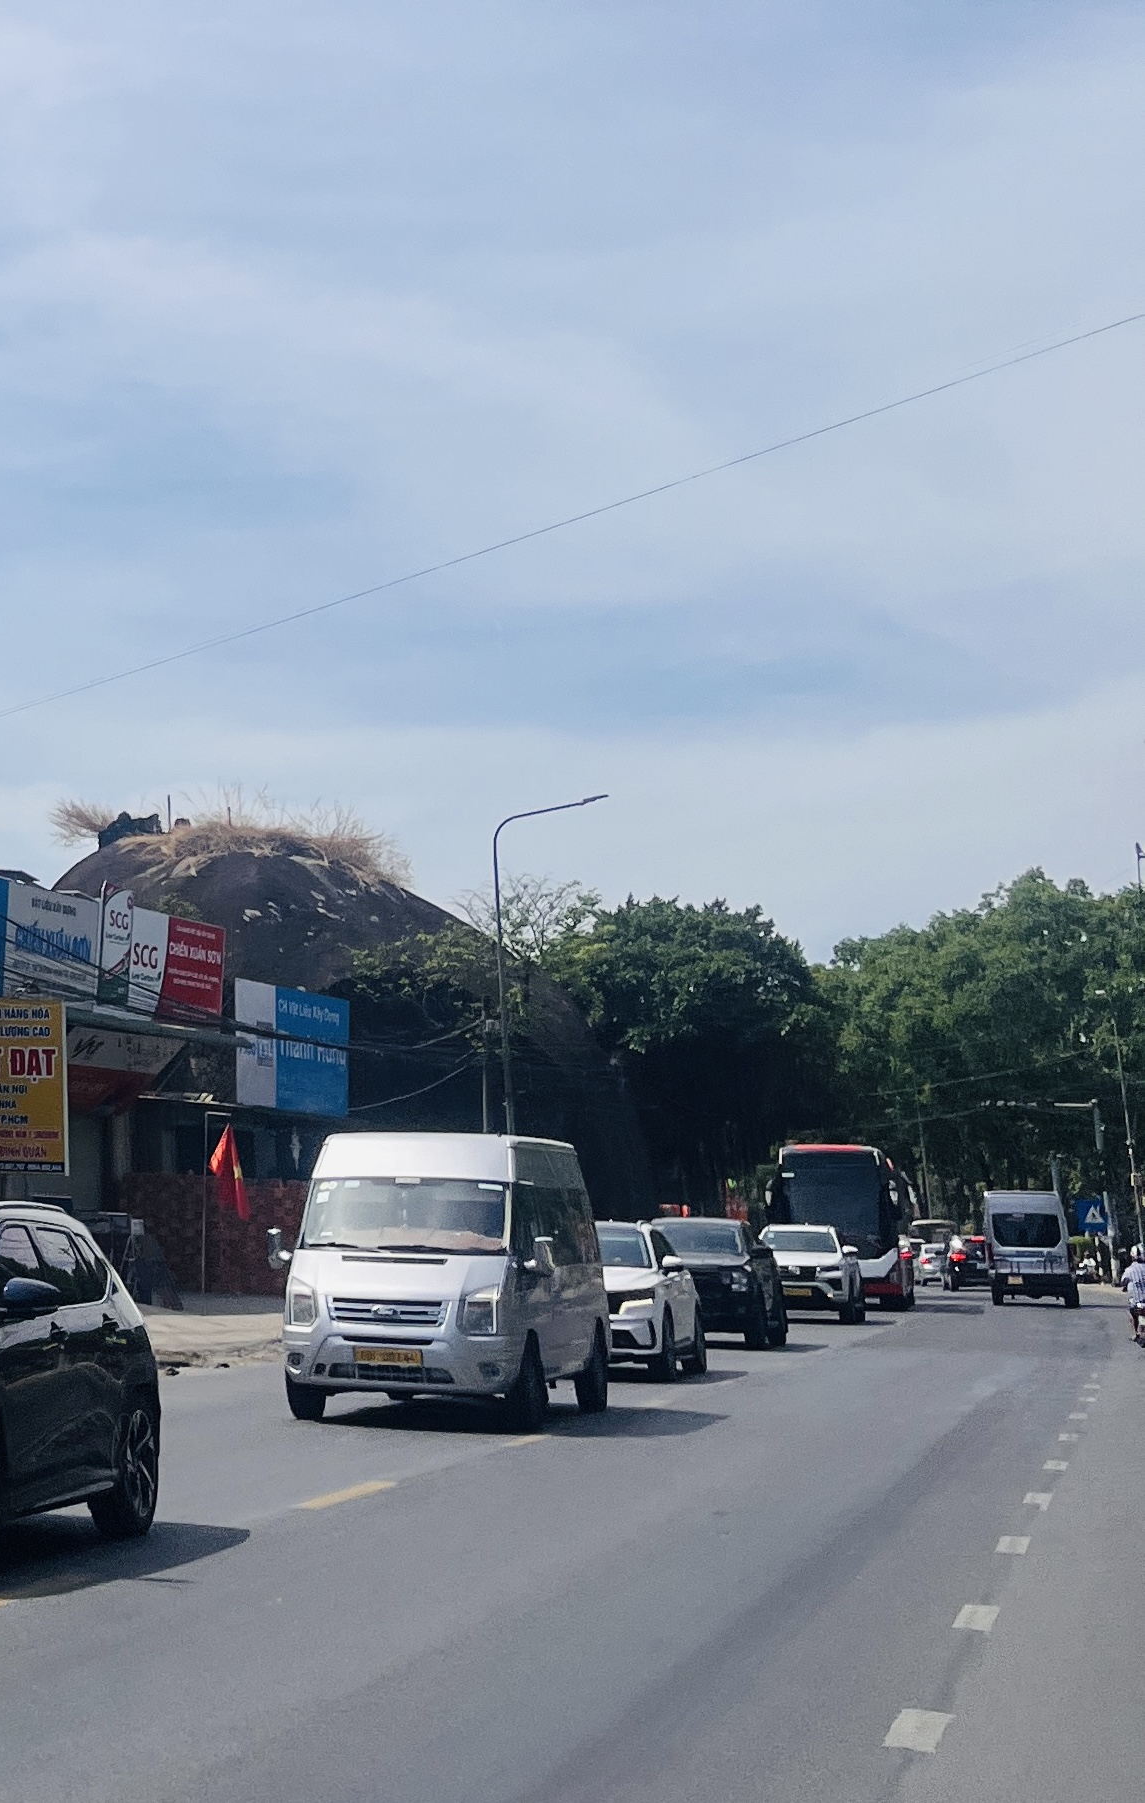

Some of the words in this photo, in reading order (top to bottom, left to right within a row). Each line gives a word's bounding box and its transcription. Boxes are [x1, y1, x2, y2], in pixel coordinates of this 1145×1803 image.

[109, 910, 129, 930] SCG
[133, 943, 158, 970] SCG
[32, 1027, 51, 1037] CAO
[10, 1048, 56, 1083] ĐẠT
